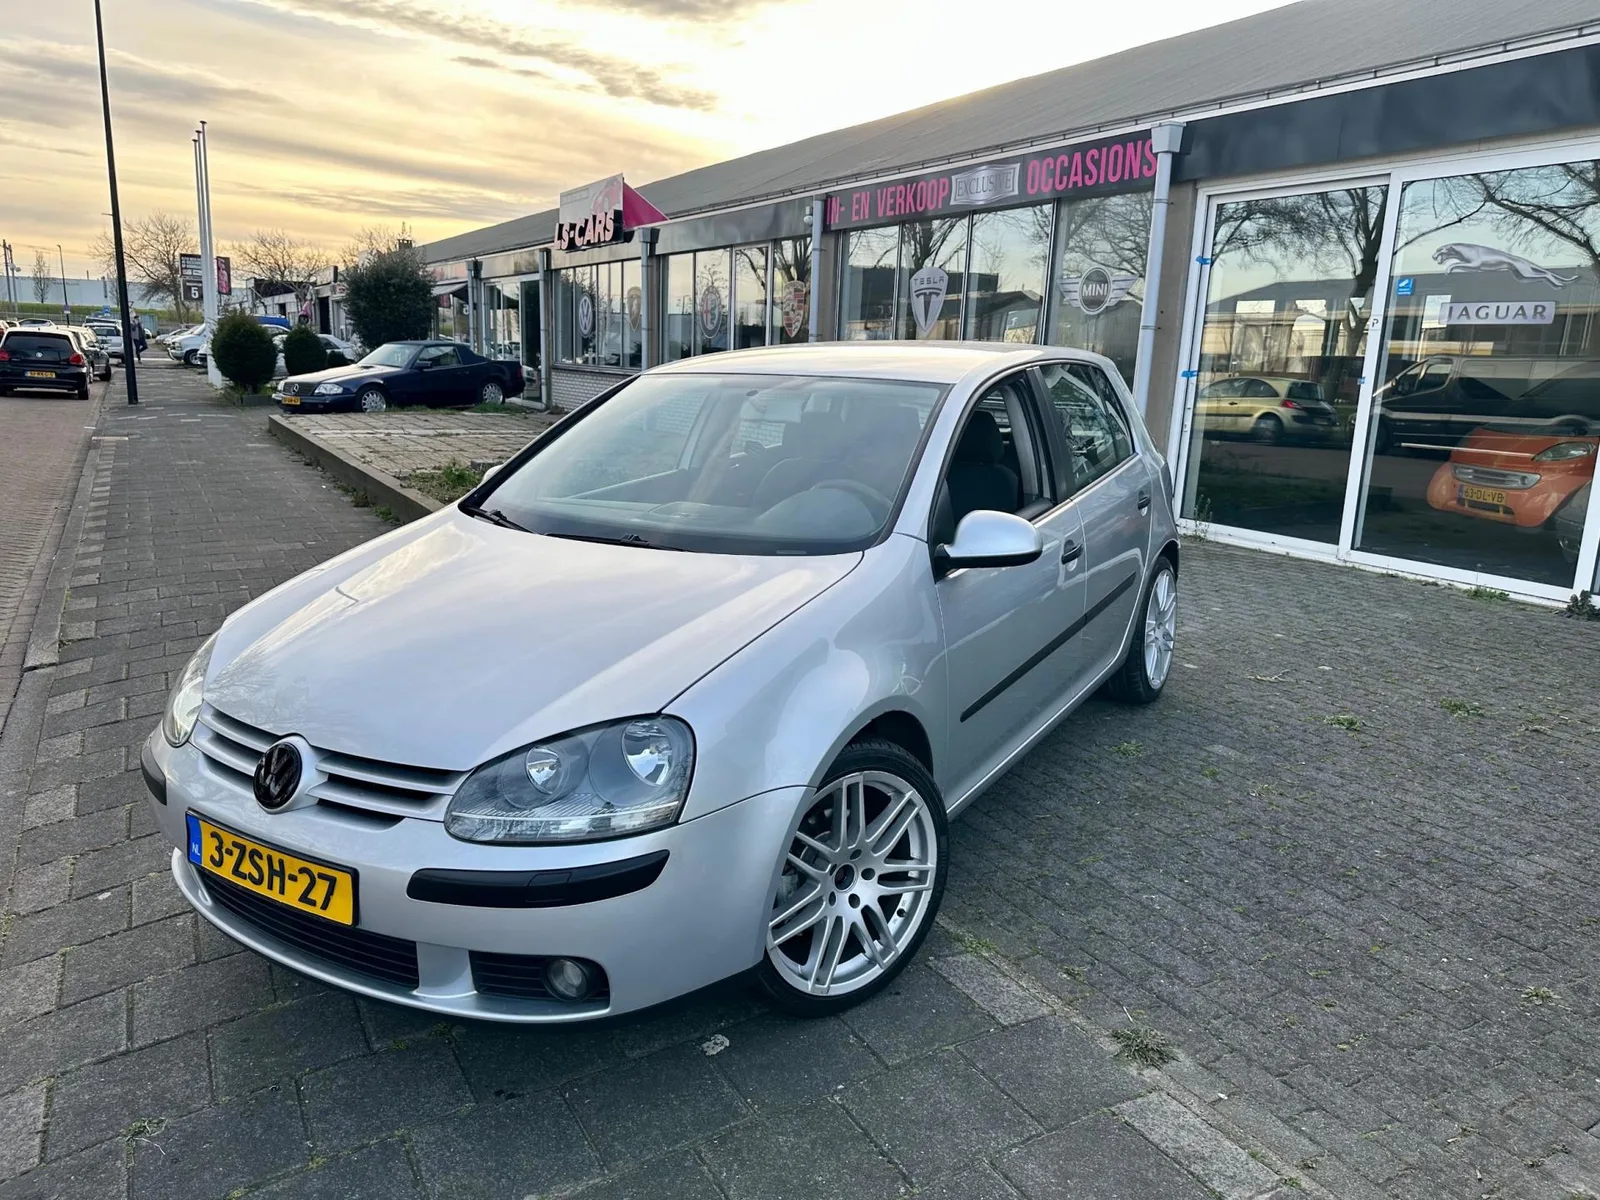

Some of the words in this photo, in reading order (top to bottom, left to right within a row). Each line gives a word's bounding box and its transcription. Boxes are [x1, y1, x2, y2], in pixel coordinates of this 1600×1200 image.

[827, 196, 846, 225] IN-
[852, 191, 870, 221] EN
[877, 177, 949, 218] VERKOOP
[1026, 139, 1158, 195] OCCASIONS
[554, 207, 615, 250] LS-CARS
[913, 275, 945, 286] TESLA
[191, 286, 199, 299] 5
[1082, 283, 1108, 297] MINI
[1448, 304, 1548, 321] JAGUAR
[209, 831, 338, 911] 3-ZSH-27
